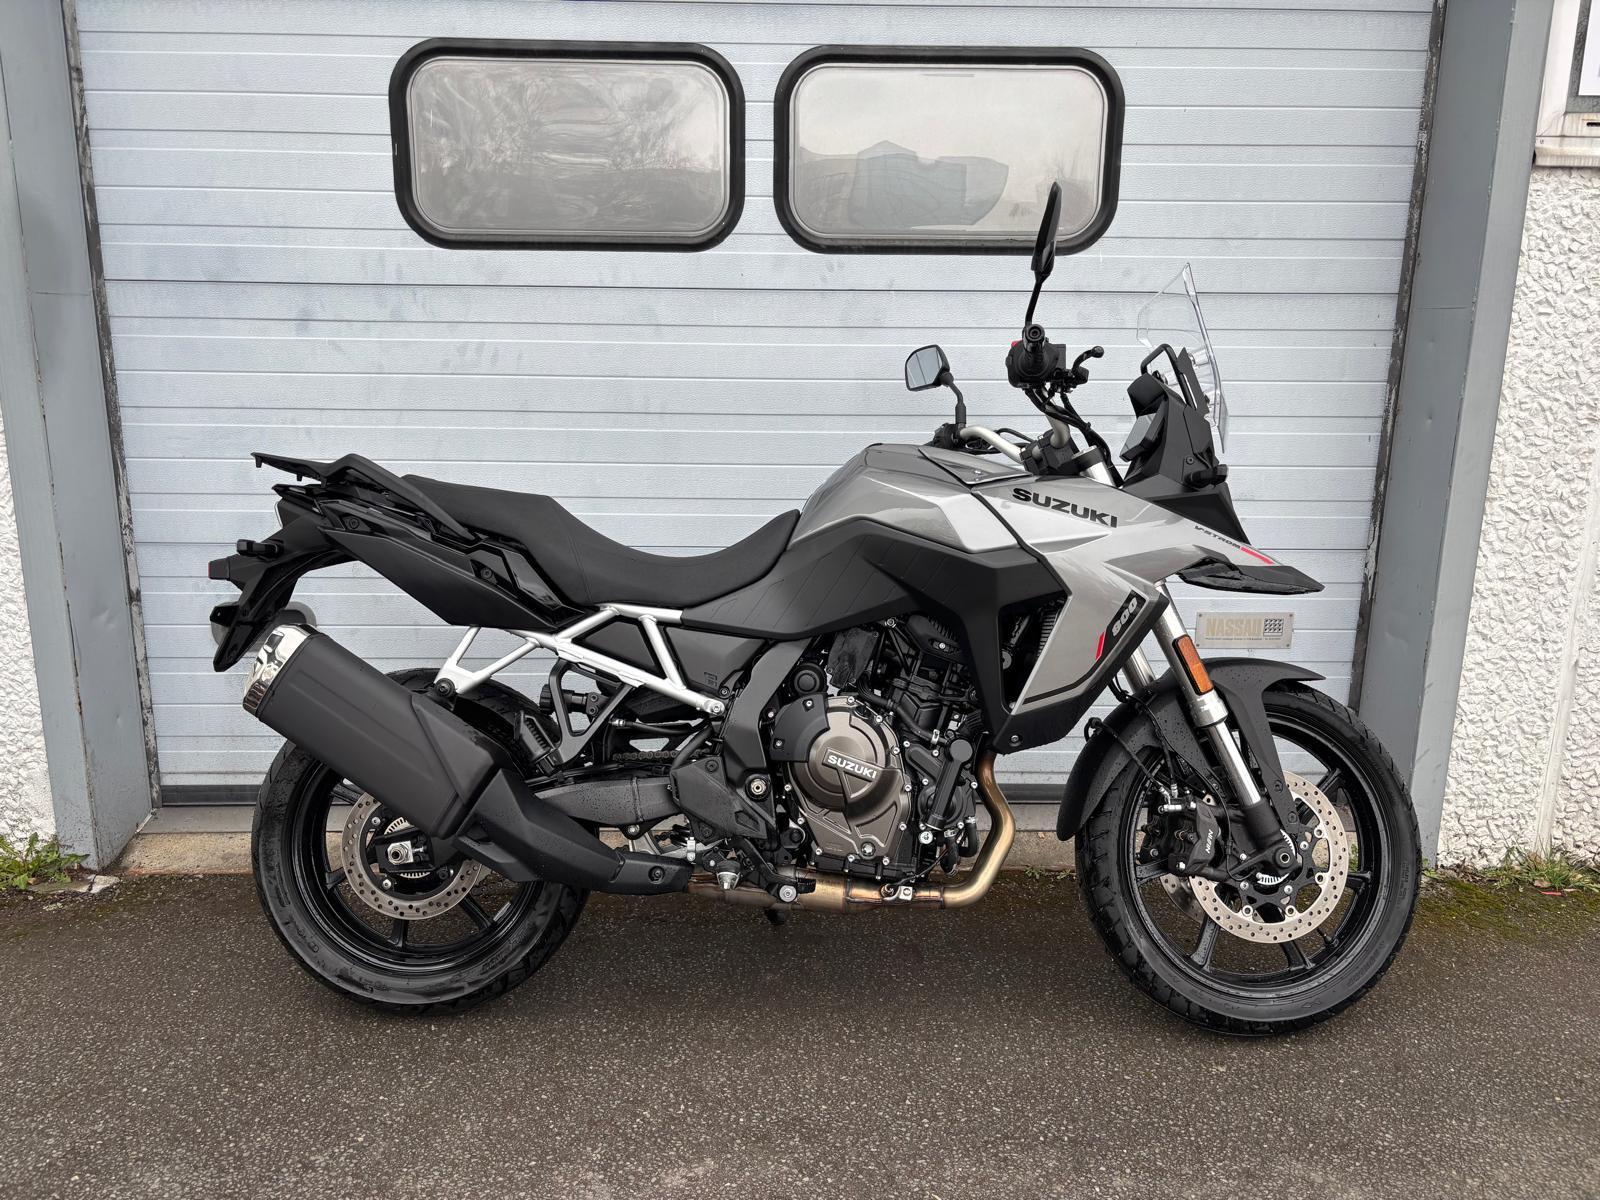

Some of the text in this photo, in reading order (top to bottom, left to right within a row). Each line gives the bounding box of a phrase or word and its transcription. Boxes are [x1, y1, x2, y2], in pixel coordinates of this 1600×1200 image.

[1012, 488, 1118, 528] SUZUKI
[1112, 597, 1137, 637] 800
[1206, 618, 1263, 637] NASSAU
[827, 755, 877, 779] SUZUKI
